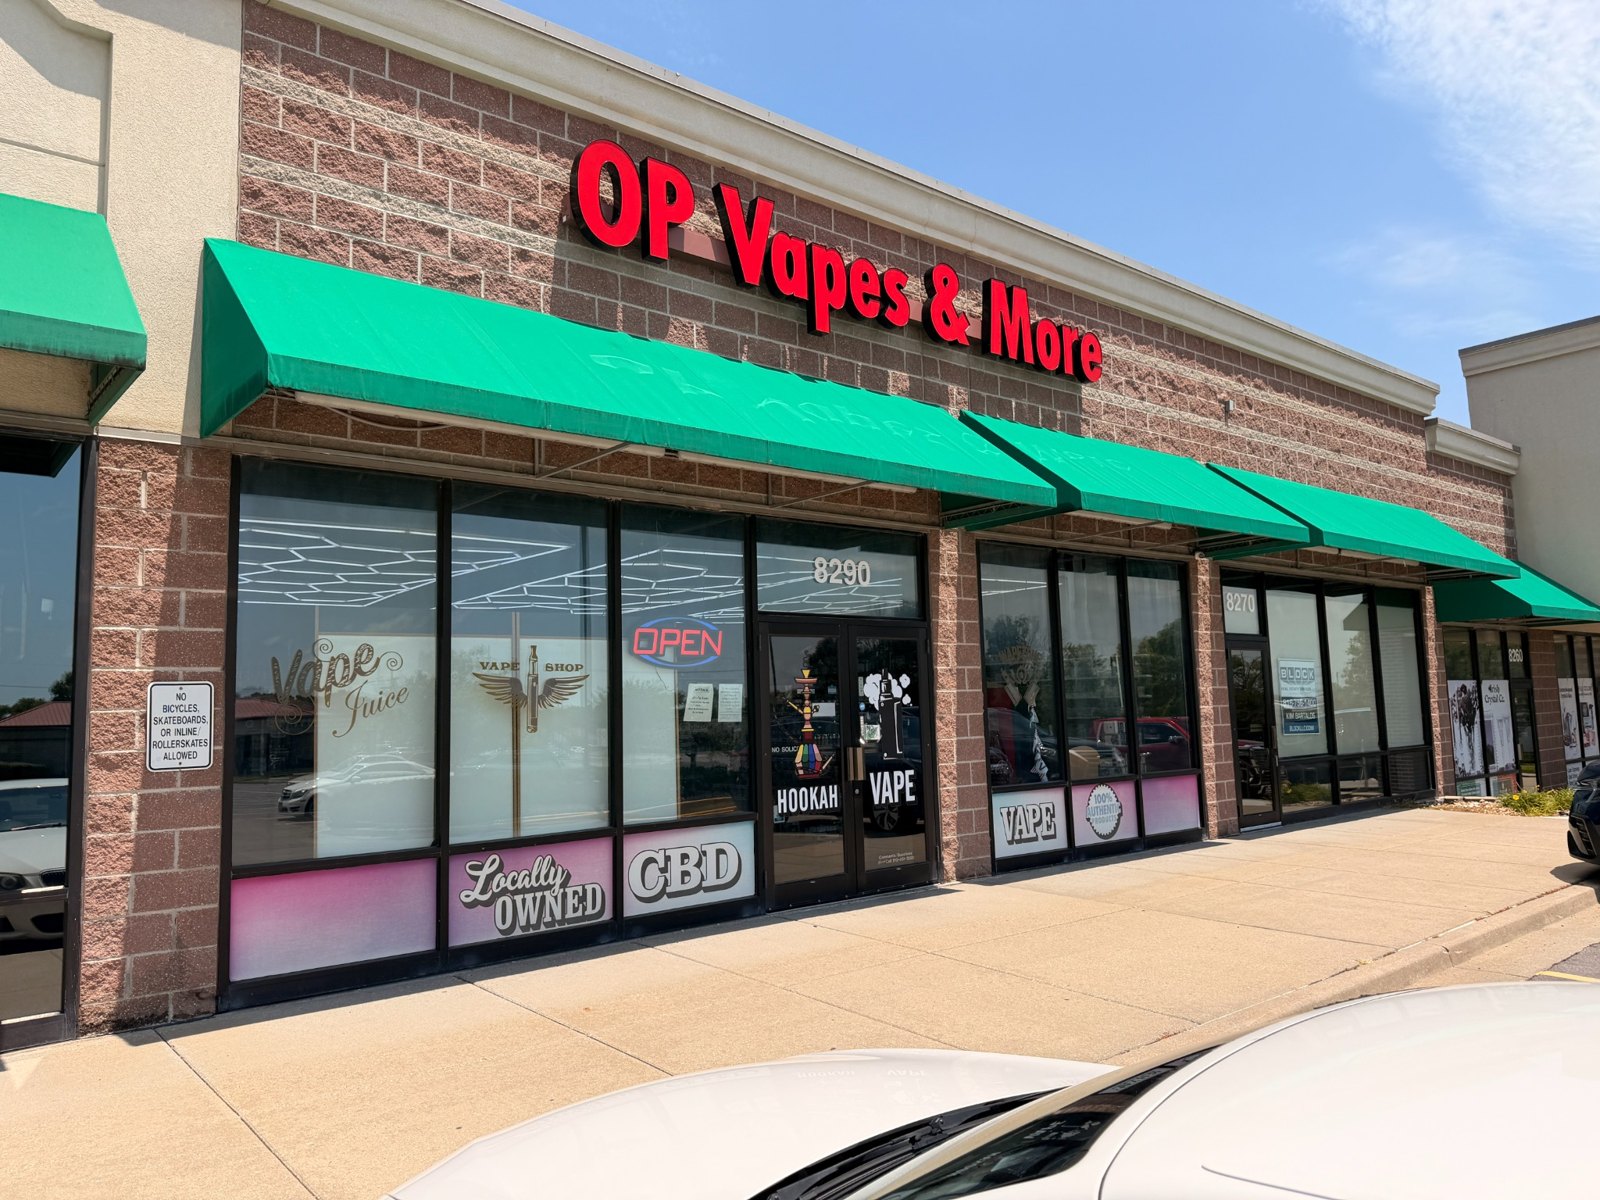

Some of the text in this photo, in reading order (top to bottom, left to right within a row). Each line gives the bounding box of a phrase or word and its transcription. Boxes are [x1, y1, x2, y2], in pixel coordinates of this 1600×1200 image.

[572, 139, 1103, 383] OP Vapes & More
[814, 556, 871, 587] 8290
[1226, 592, 1255, 612] 8270
[633, 628, 723, 656] OPEN
[479, 661, 584, 672] VAPE SHOP
[1508, 648, 1524, 662] 8260
[271, 639, 390, 715] Vape
[1280, 668, 1315, 679] BLOCK
[162, 704, 200, 713] BICYCLES,
[176, 692, 187, 701] NO
[153, 715, 209, 725] SKATEBOARDS,
[332, 680, 410, 738] Juice
[152, 739, 208, 749] ROLLERSKATES
[160, 728, 171, 737] OR
[163, 751, 198, 760] ALLOWED
[777, 784, 839, 814] HOOKAH
[869, 769, 916, 805] VAPE
[1094, 792, 1113, 804] 100%
[1000, 801, 1057, 845] VAPE
[459, 853, 571, 906] Locally
[628, 841, 742, 902] CBD
[494, 883, 604, 934] OWNED
